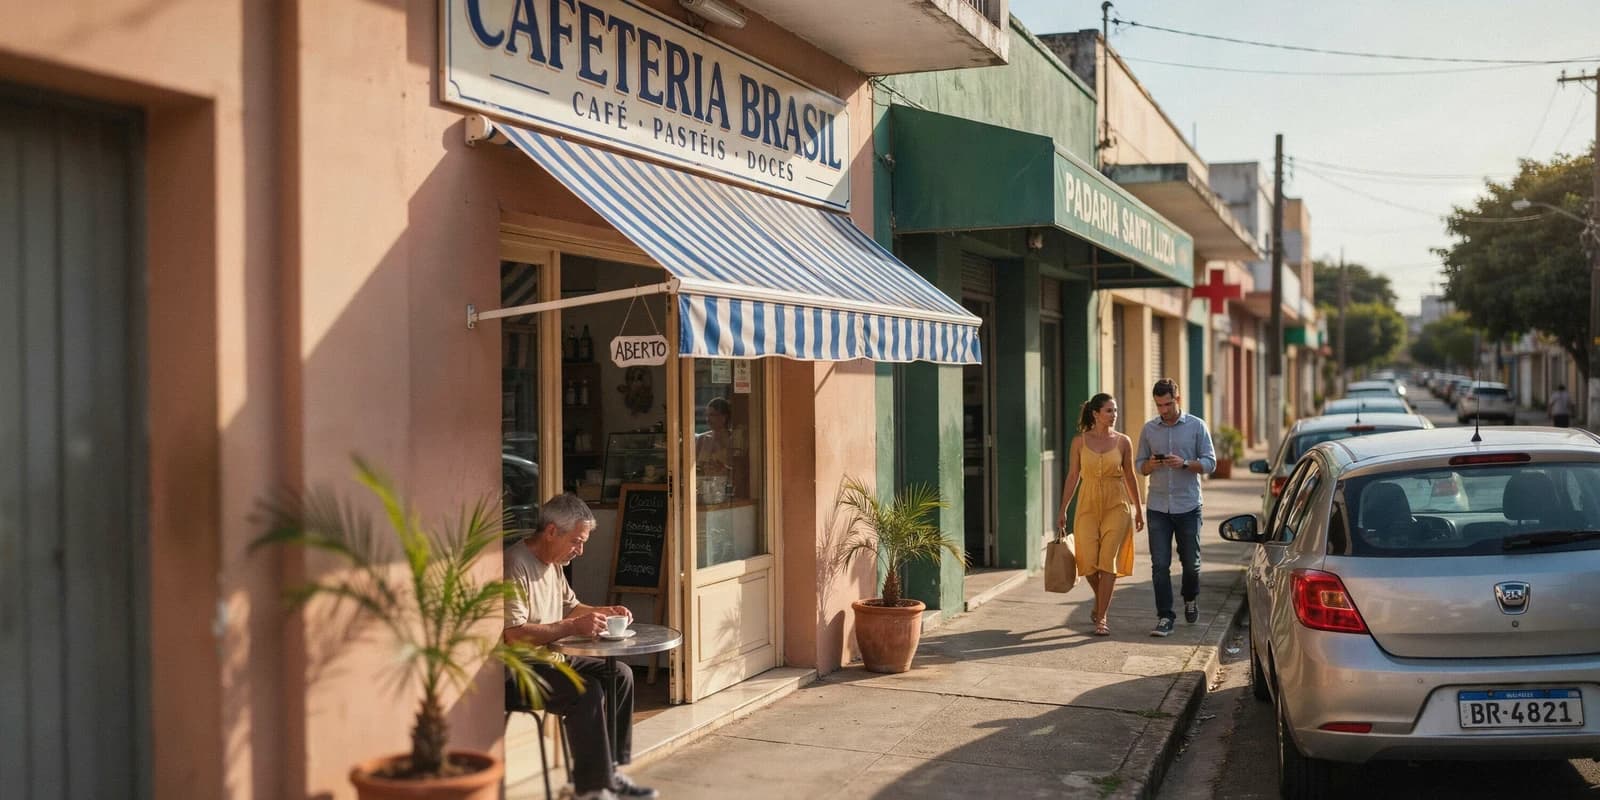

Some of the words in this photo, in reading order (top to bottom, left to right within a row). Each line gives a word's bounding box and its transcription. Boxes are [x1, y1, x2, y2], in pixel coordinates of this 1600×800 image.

[573, 91, 628, 130] CAFÉ
[653, 117, 726, 160] PASTÉIS
[747, 151, 793, 182] DOCES
[739, 74, 842, 170] BRASIL
[1065, 172, 1119, 239] PADARIA
[1122, 207, 1153, 257] SANTA
[1154, 226, 1176, 266] LUZIA
[615, 341, 666, 361] ABERTO
